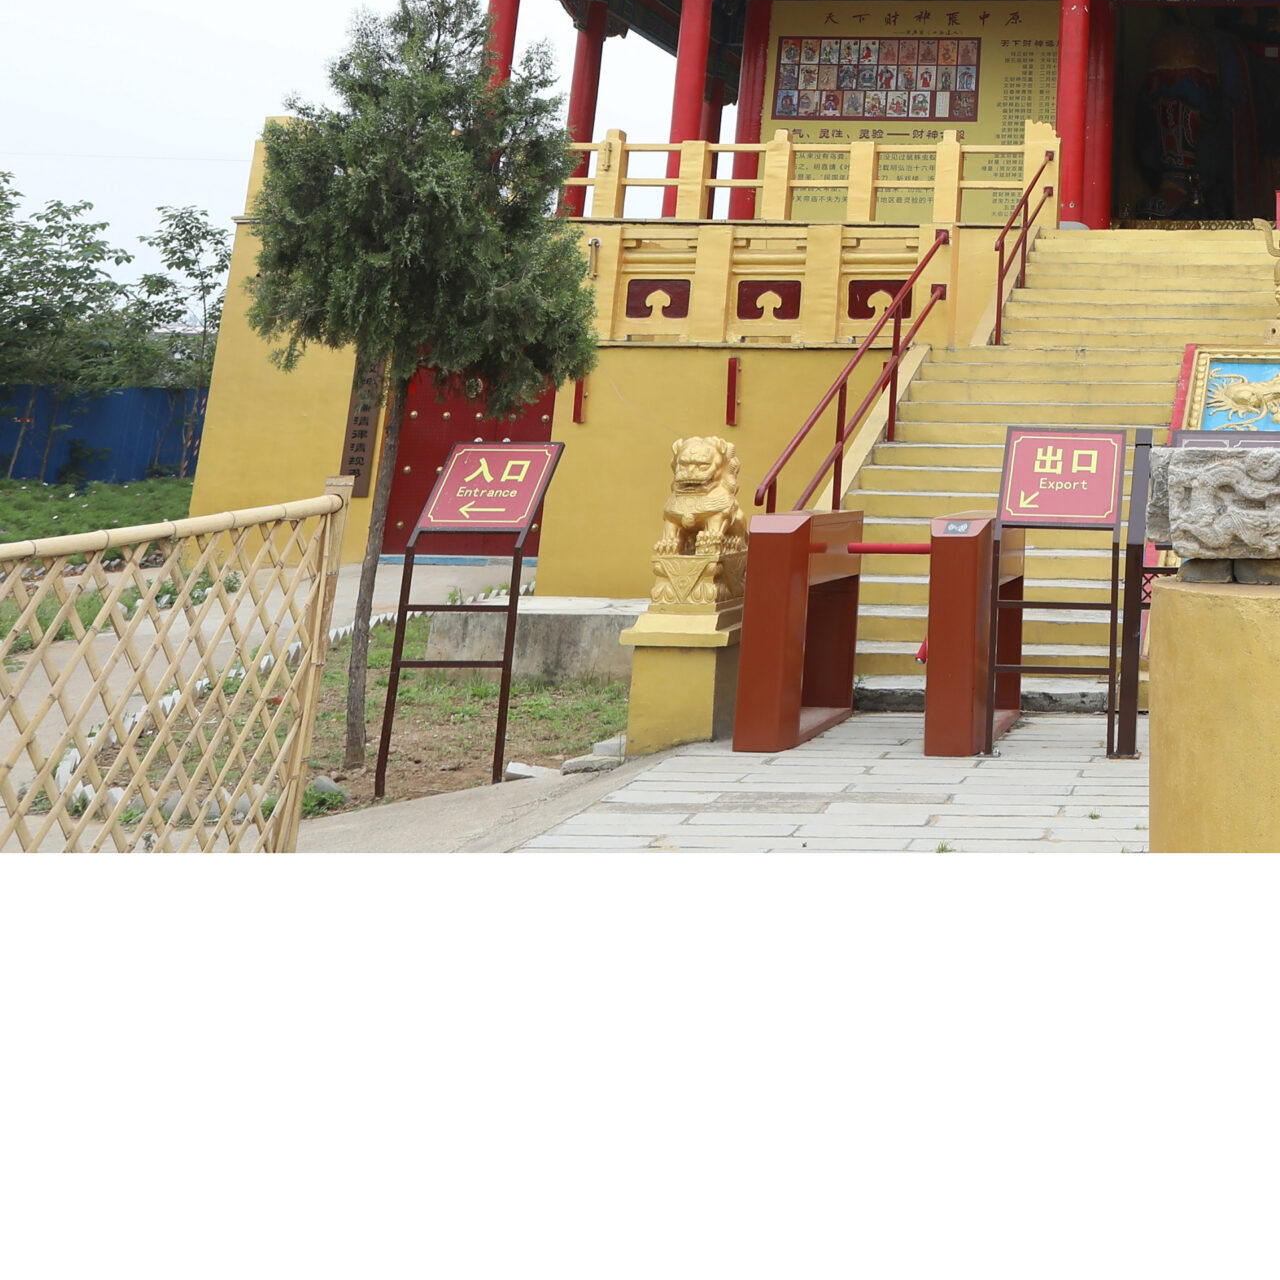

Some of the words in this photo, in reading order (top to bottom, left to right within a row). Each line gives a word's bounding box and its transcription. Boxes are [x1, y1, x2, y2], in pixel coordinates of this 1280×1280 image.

[1001, 39, 1059, 47] 天下财神诞
[1034, 446, 1098, 474] 出口
[464, 458, 531, 483] 入口
[1039, 478, 1088, 491] Export
[456, 486, 518, 499] Entrance
